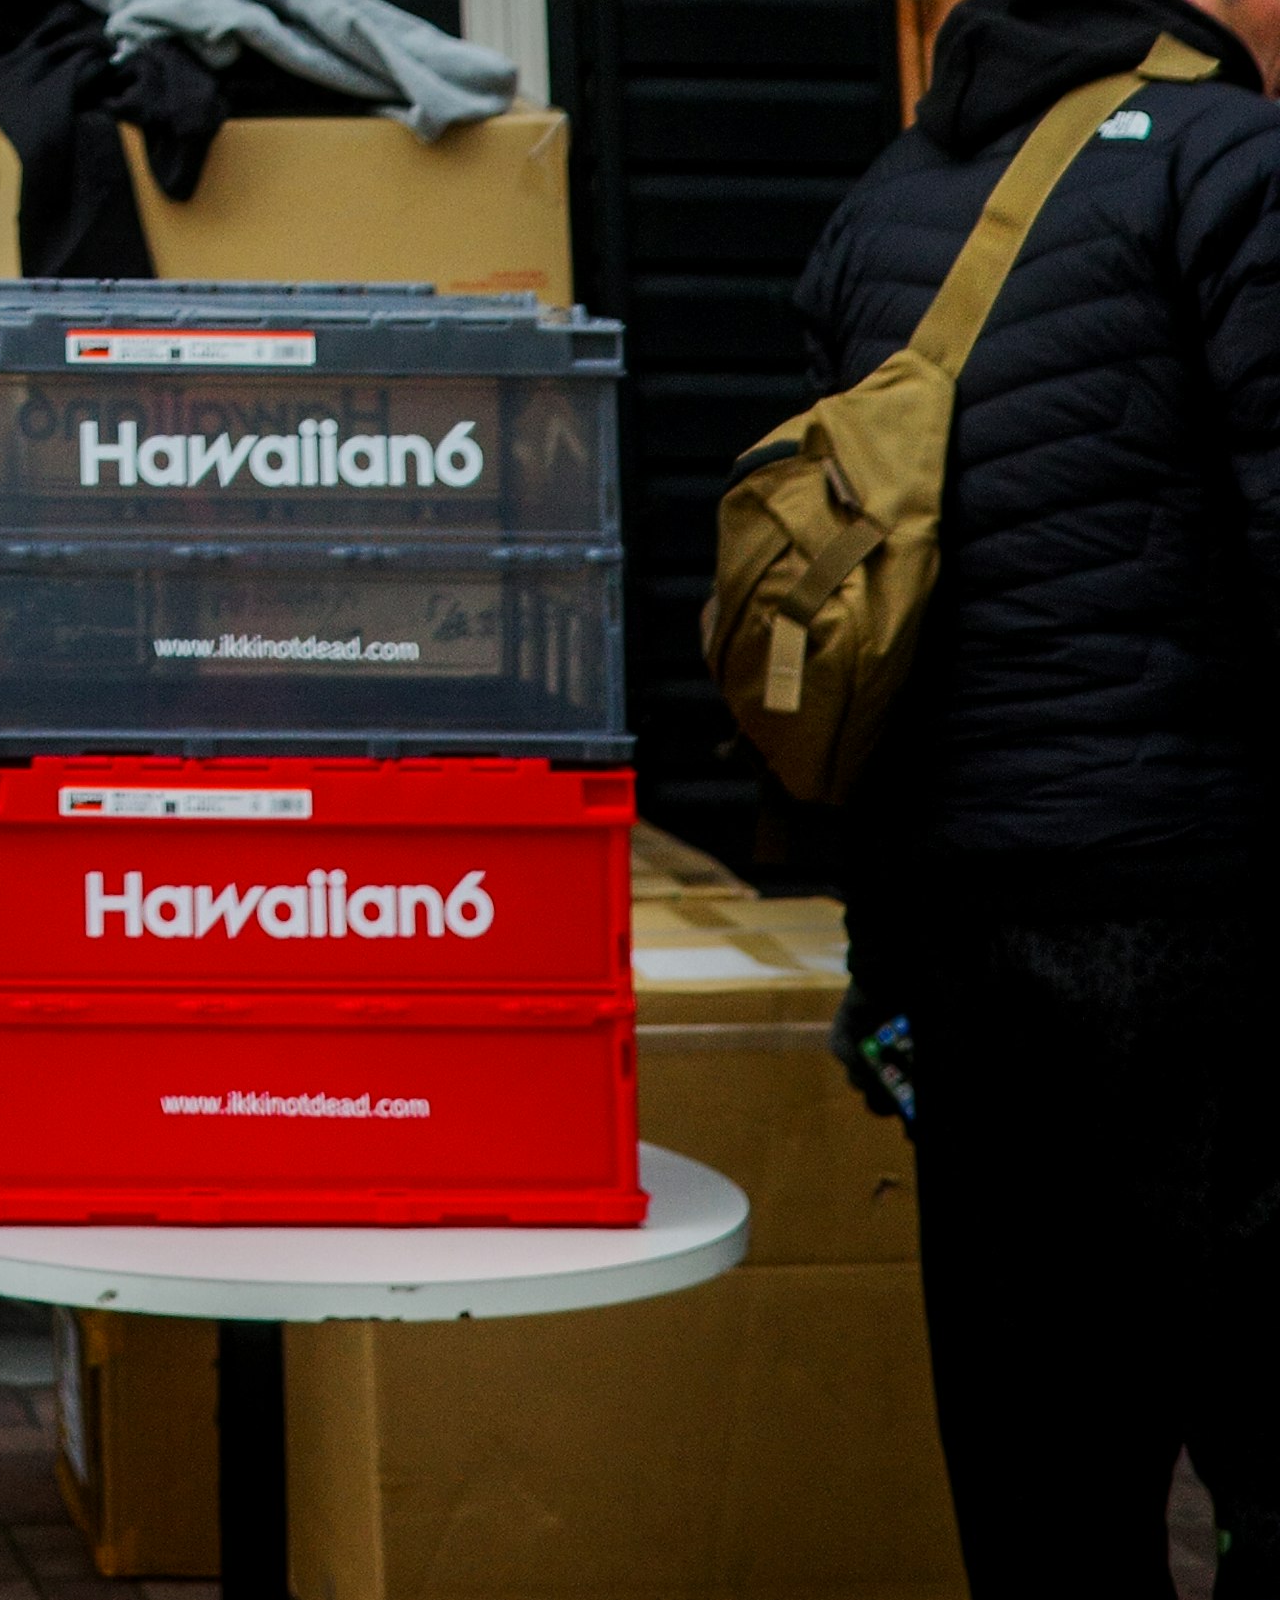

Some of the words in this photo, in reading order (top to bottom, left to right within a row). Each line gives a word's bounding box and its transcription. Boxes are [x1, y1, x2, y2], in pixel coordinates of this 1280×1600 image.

[78, 418, 485, 488] Hawaiian6
[153, 633, 421, 663] www.ikkinotdead.com
[85, 868, 495, 939] Hawaiian6
[160, 1091, 432, 1120] www.ikkinotdead.com
